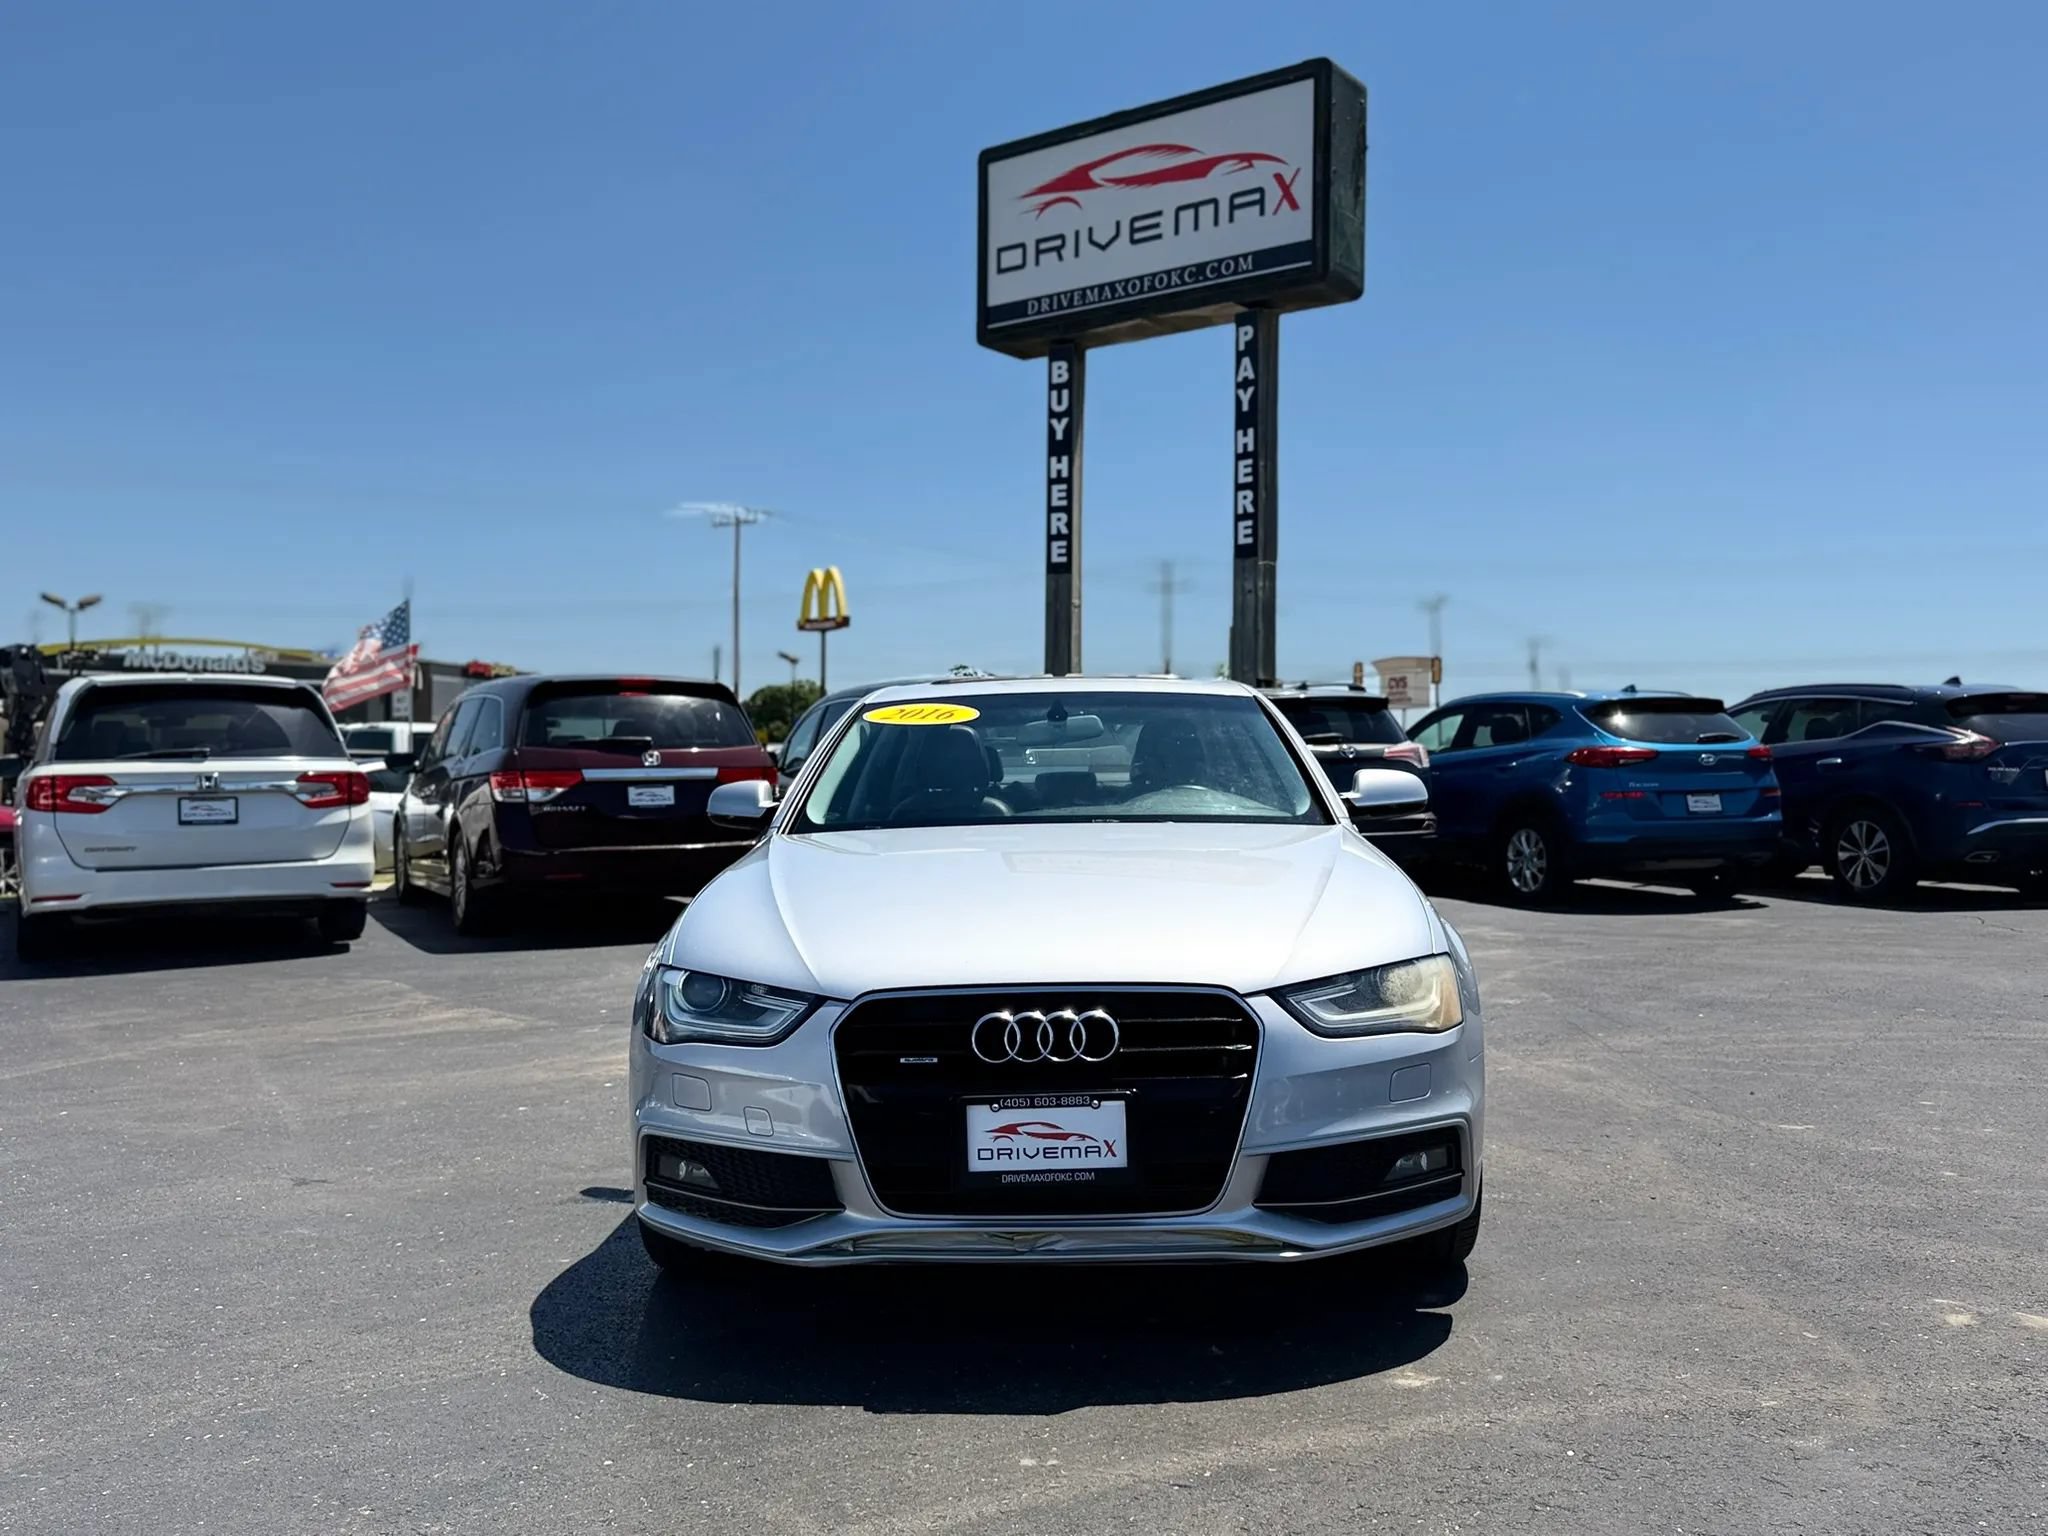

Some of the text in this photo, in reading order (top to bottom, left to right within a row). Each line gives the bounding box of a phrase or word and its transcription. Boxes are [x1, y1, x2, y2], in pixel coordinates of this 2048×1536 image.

[996, 167, 1302, 274] DRIVEMAX
[1026, 254, 1255, 316] DRIVEMAXOFOKC.COM
[1050, 360, 1070, 564] BUY HERE
[1236, 325, 1256, 546] PAY HERE
[879, 708, 958, 721] 2016
[1000, 1095, 1091, 1108] (405) 603-8883
[977, 1139, 1118, 1161] DRIVEMAX
